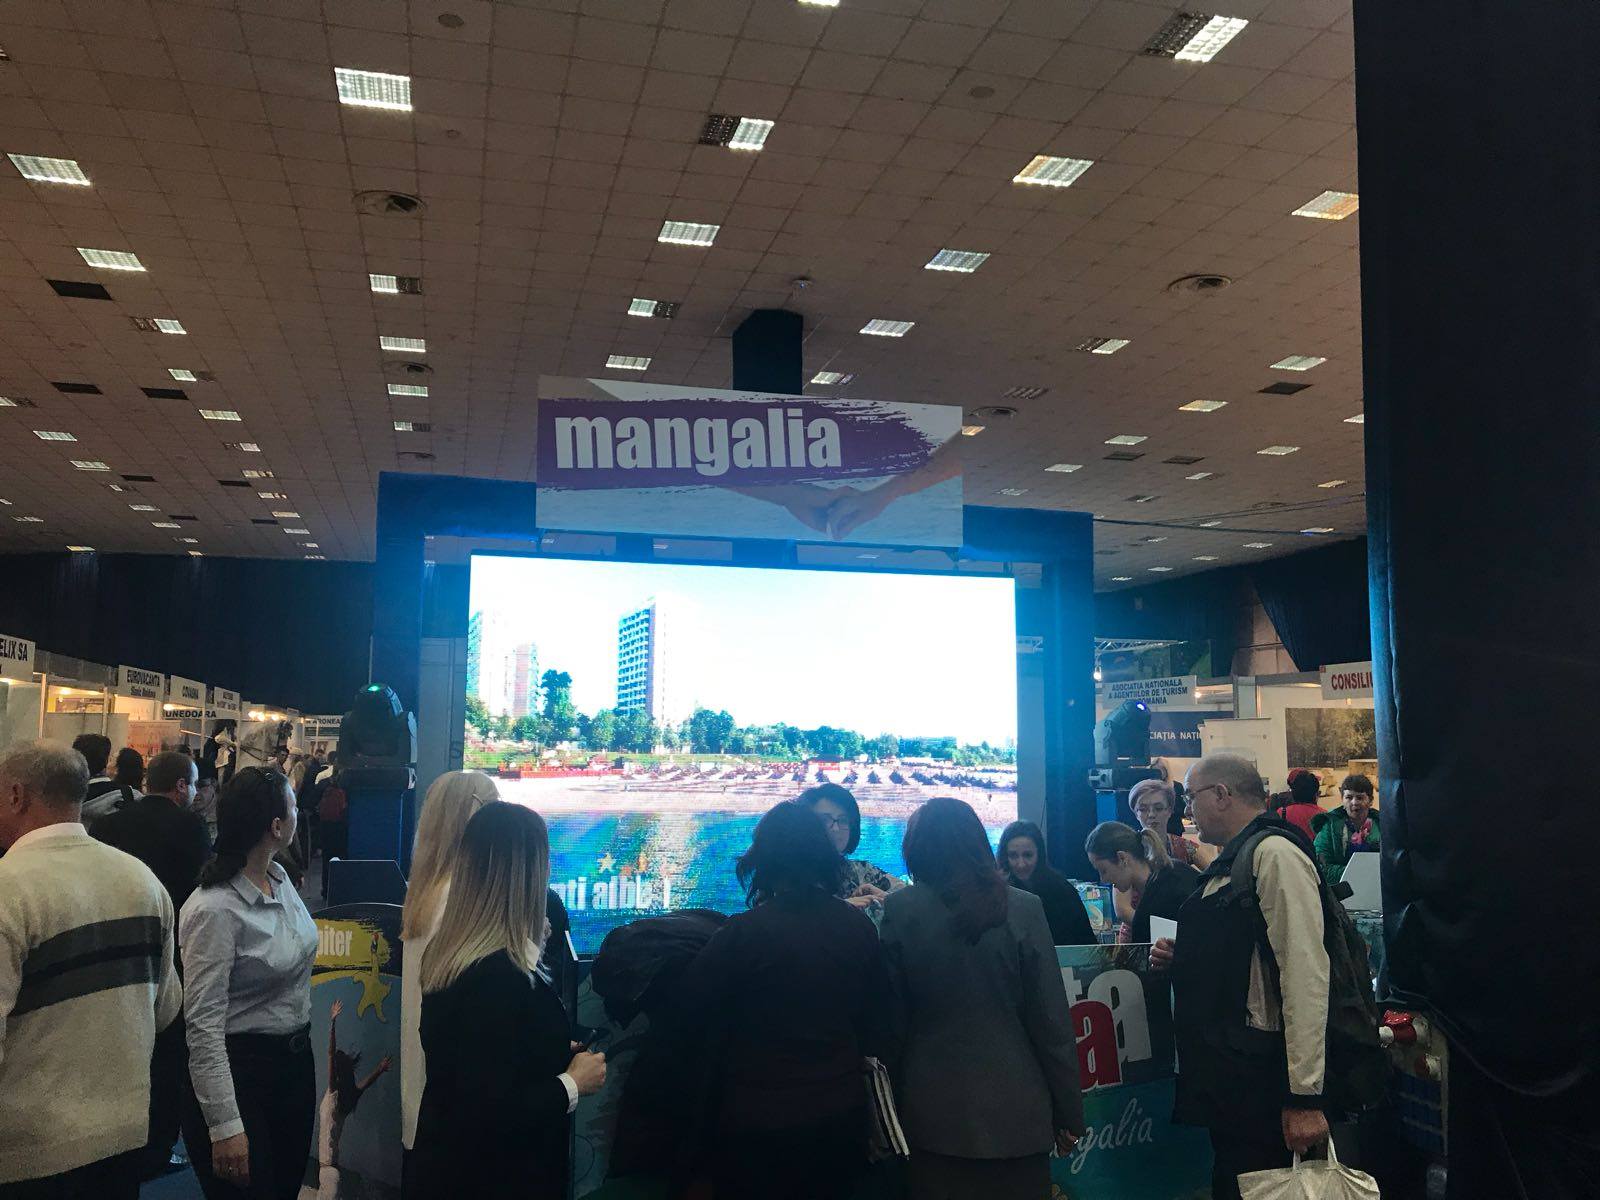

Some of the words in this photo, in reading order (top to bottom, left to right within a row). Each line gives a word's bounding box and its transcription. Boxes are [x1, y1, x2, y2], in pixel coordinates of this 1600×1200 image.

[554, 408, 842, 476] mangalia
[18, 642, 28, 662] SA
[1112, 682, 1143, 692] ASOCIATIA
[1144, 679, 1183, 689] NATIONALA
[1162, 686, 1188, 696] TURISM
[1049, 1097, 1152, 1174] galia
